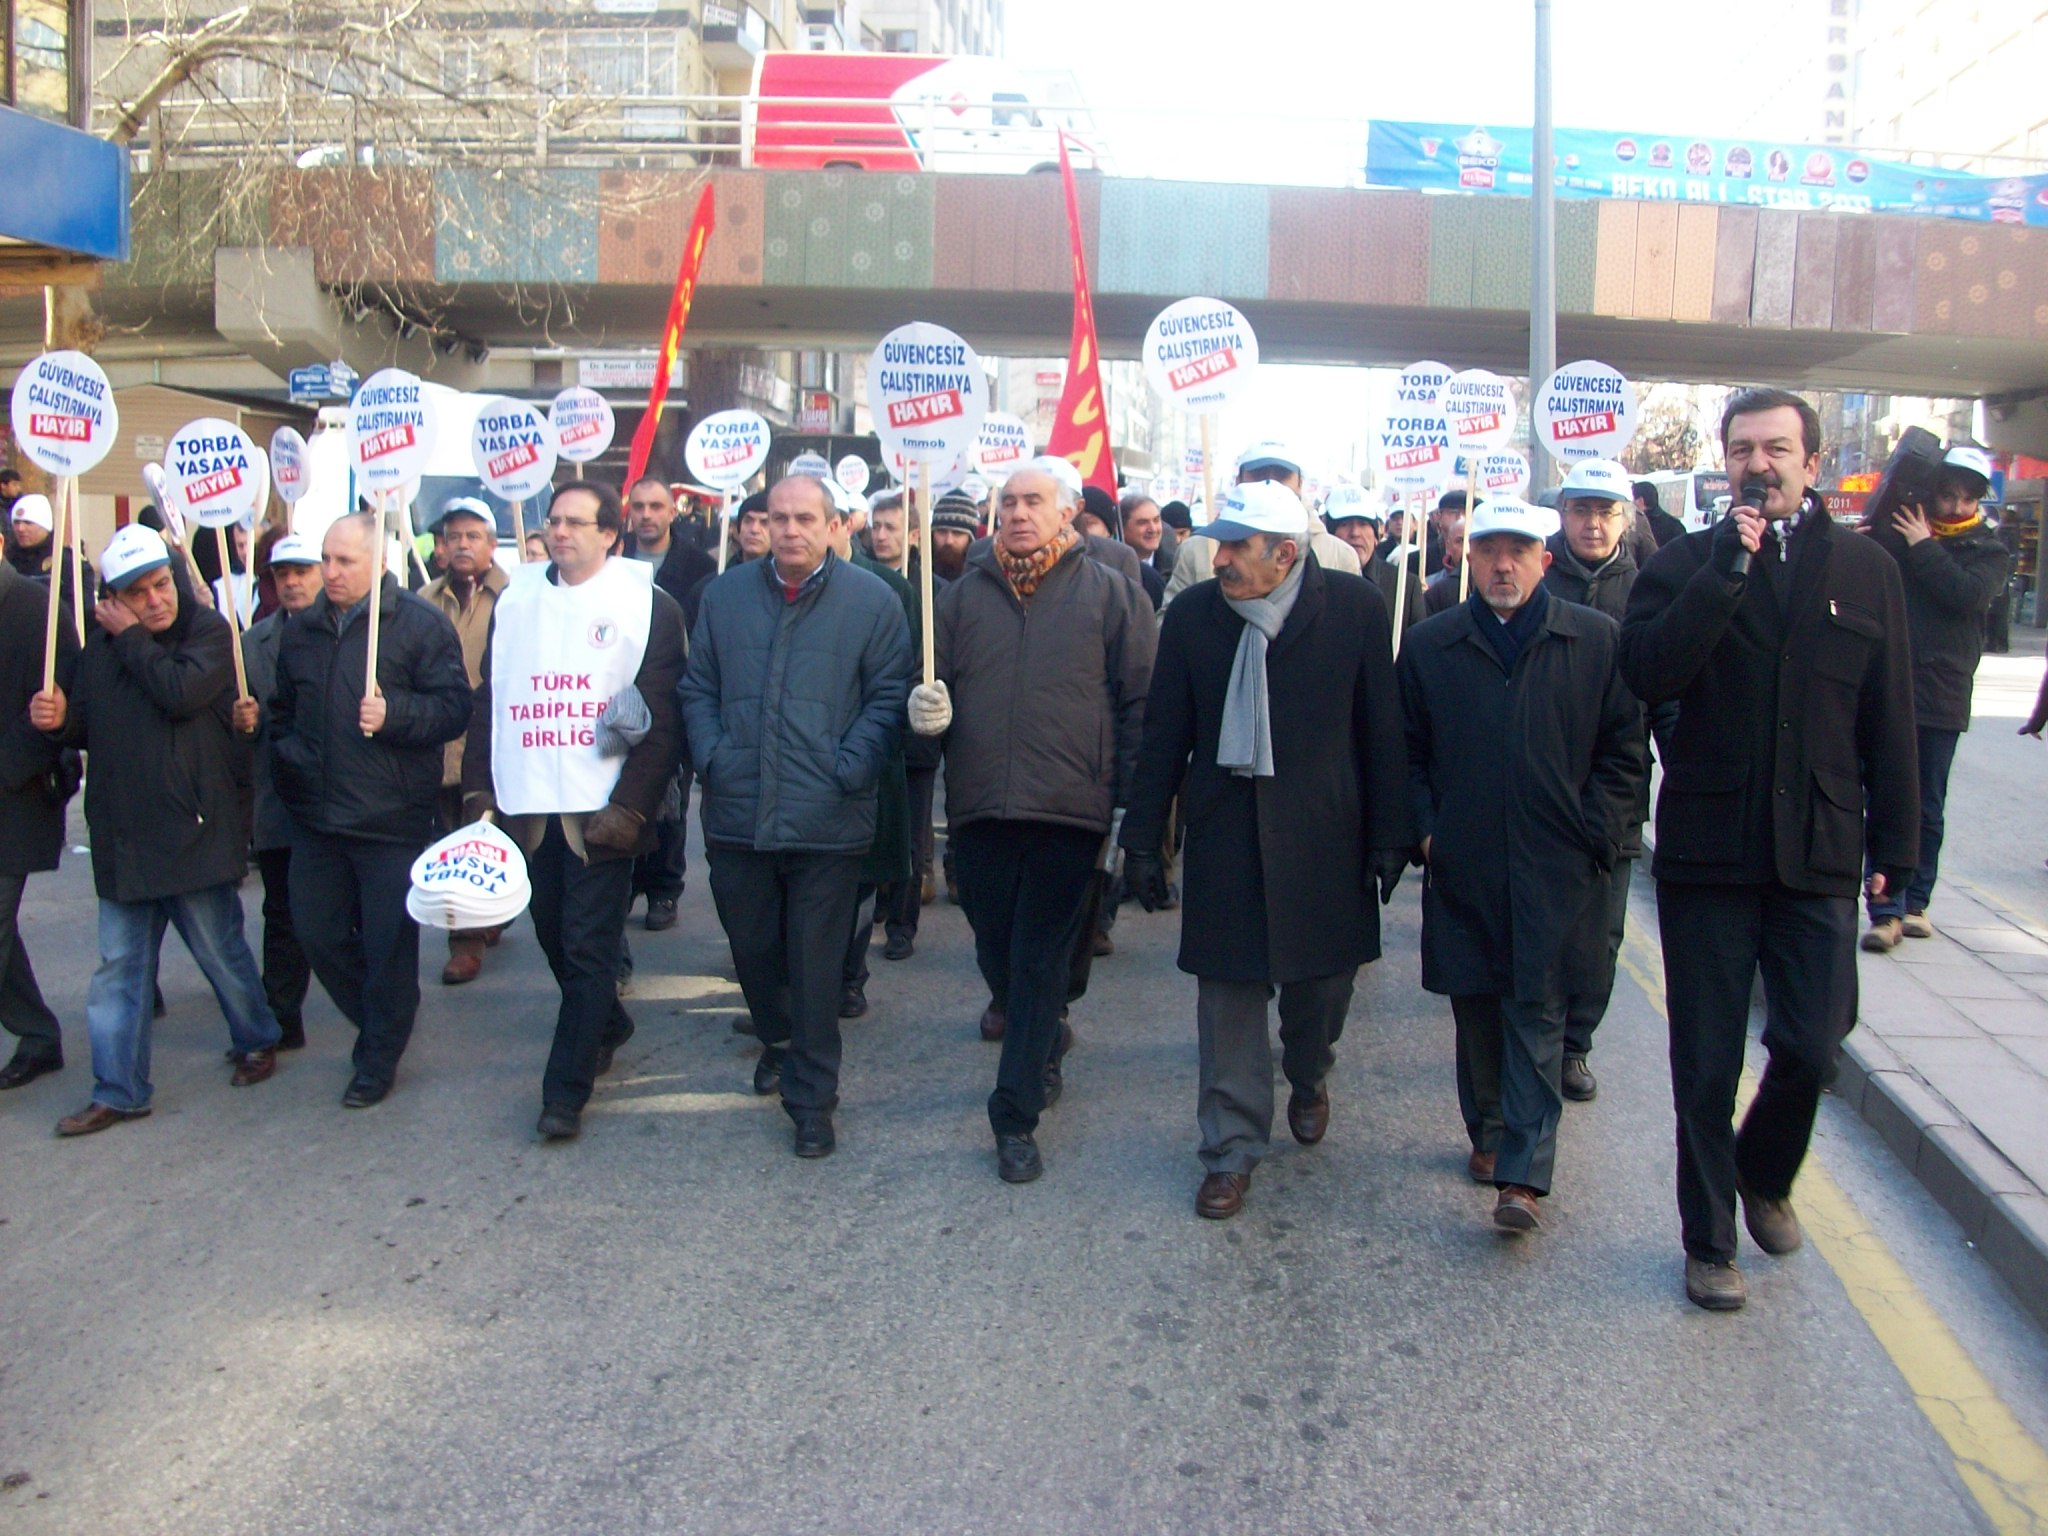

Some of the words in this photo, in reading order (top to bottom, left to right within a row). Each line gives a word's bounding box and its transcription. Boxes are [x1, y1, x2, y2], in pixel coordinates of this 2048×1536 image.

[1159, 308, 1234, 337] GÜVENCESİZ
[884, 338, 965, 366] GÜVENCESİZ
[1158, 334, 1243, 366] ÇALIŞTIRMAYA
[39, 360, 105, 400] GÜVENCESİZ
[1173, 352, 1230, 387] HAYIR
[881, 370, 972, 398] ÇALIŞTIRMAYA
[1554, 371, 1622, 394] GÜVENCESİZ
[29, 384, 102, 426] ÇALIŞTIRMAYA
[360, 383, 420, 407] GÜVENCESİZ
[1187, 392, 1226, 405] tmmob
[1398, 389, 1439, 401] YASA
[894, 394, 954, 423] HAYIR
[1548, 396, 1624, 417] ÇALIŞTIRMAYA
[35, 415, 86, 438] HAYIR
[479, 412, 537, 433] TORBA
[705, 420, 760, 435] TORBA
[983, 422, 1024, 436] TORBA
[1387, 418, 1447, 431] TORBA
[1557, 415, 1608, 437] HAYIR
[364, 427, 409, 459] HAYIR
[479, 431, 544, 453] YASAYA
[562, 424, 596, 444] HAYIR
[700, 435, 761, 450] YASAYA
[903, 437, 945, 449] tmmob
[978, 435, 1026, 449] YASAYA
[1381, 434, 1449, 448] YASAYA
[176, 434, 242, 457] TORBA
[1563, 447, 1599, 457] tmmob
[175, 454, 249, 477] YASAYA
[491, 447, 533, 476] HAYIR
[1389, 447, 1435, 468] HAYIR
[1487, 455, 1522, 466] TORBA
[1484, 465, 1524, 476] YASAYA
[189, 468, 237, 500] HAYIR
[1827, 497, 1850, 509] 2011
[531, 671, 592, 692] TÜRK
[509, 696, 613, 722] TABİPLER
[522, 724, 596, 748] BİRLİĞ
[446, 841, 503, 862] HAYIR
[425, 856, 508, 884] YASAYA
[424, 868, 498, 895] TORBA
